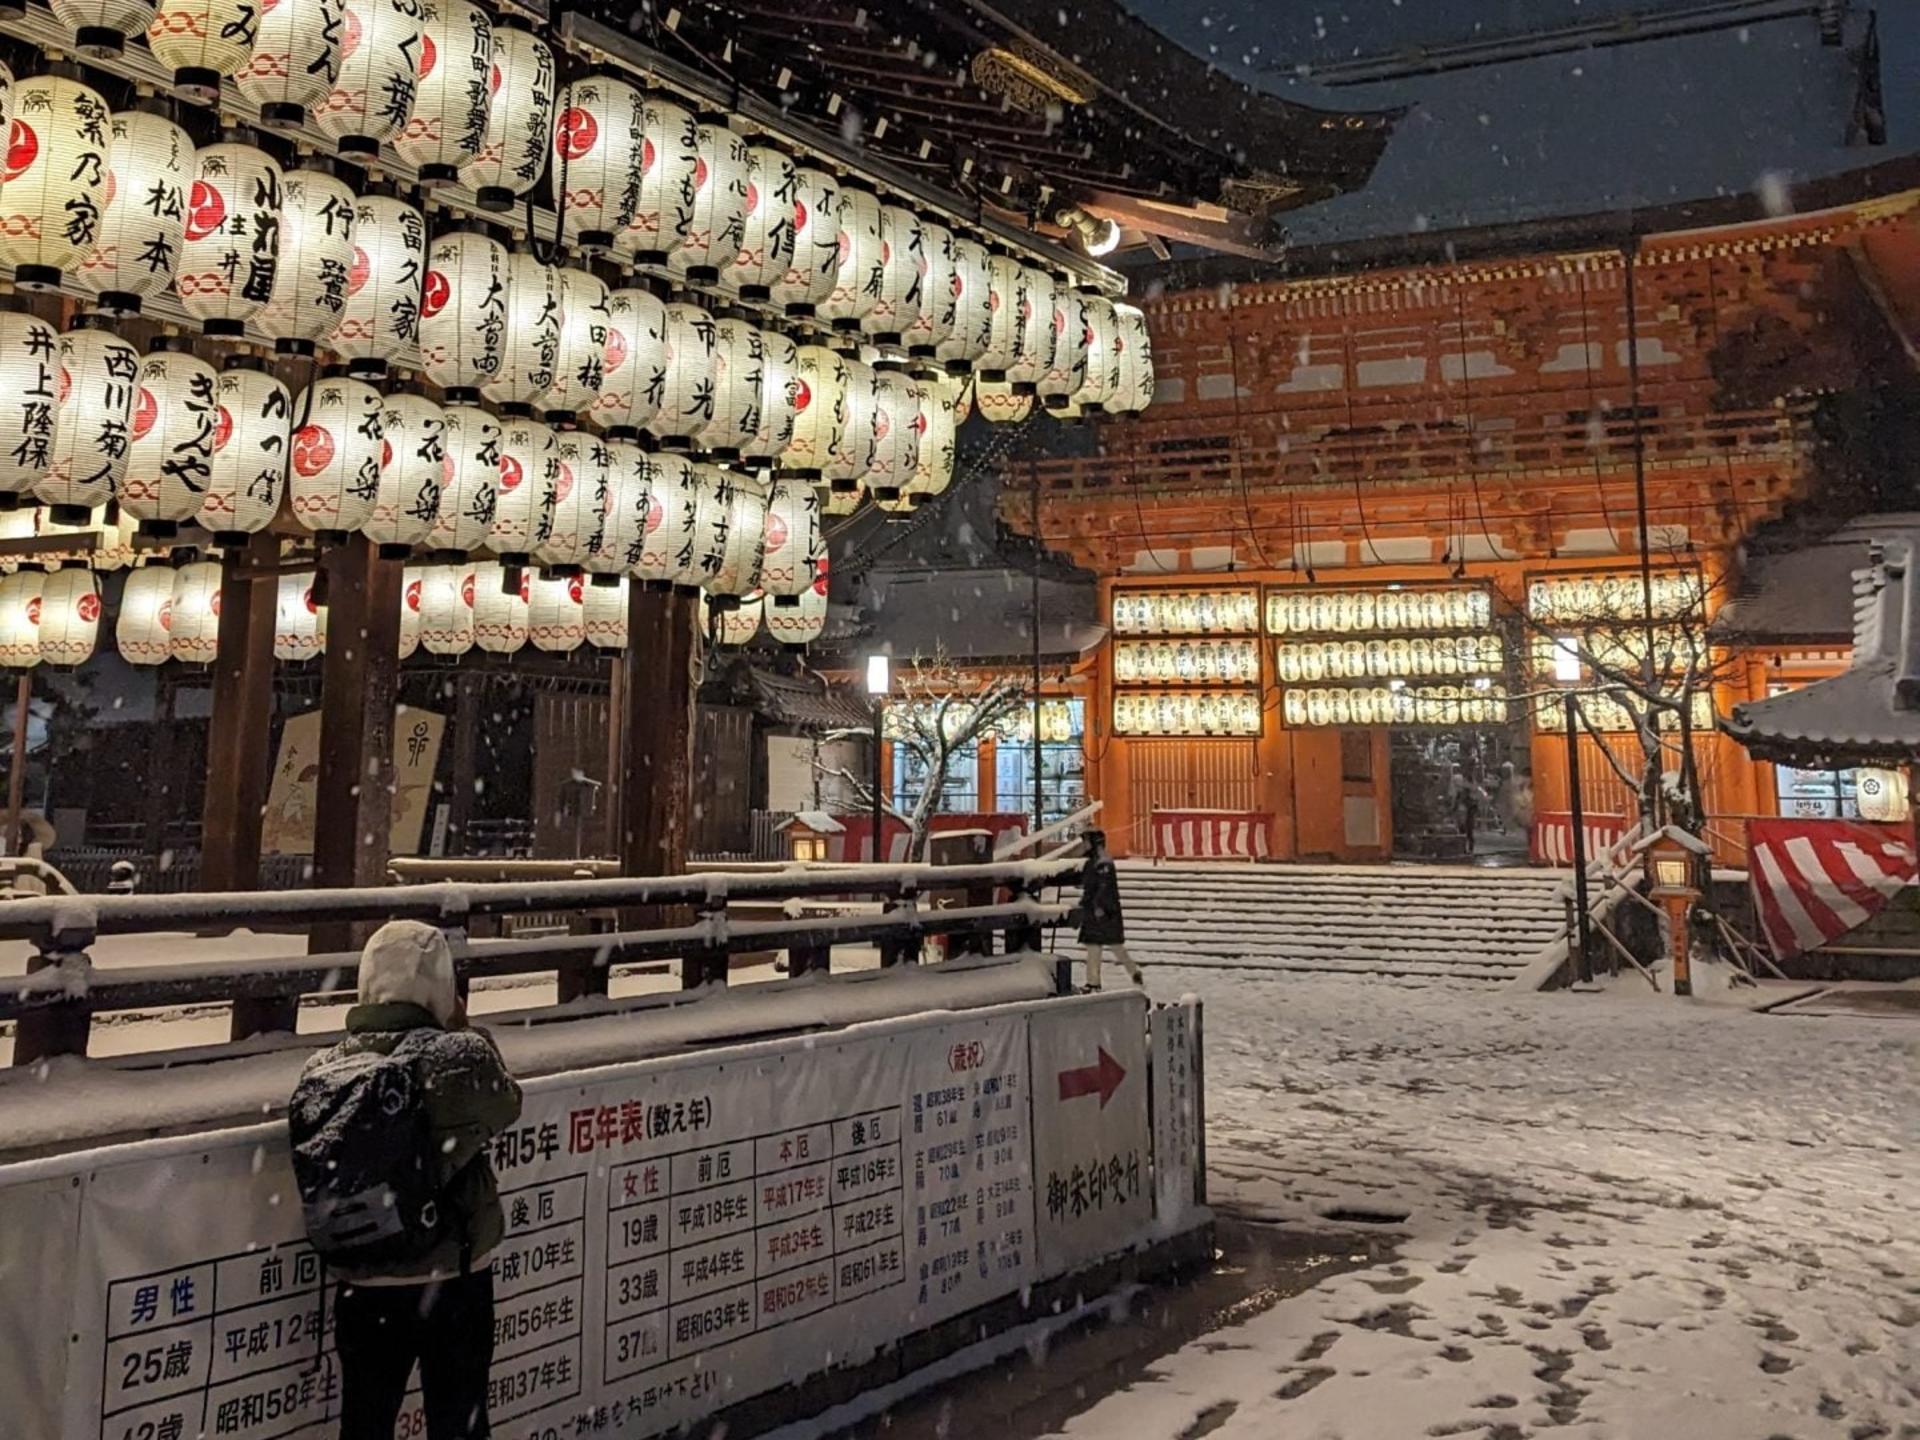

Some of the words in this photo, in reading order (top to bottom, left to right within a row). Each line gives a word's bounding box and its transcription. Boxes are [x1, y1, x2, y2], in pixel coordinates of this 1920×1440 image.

[62, 93, 108, 246] 繁乃家
[136, 178, 186, 272] 松本
[11, 325, 55, 469] 井上隆保
[486, 1122, 560, 1172] 和5年
[779, 1133, 810, 1163] 本厄
[852, 1117, 882, 1146] 後厄
[623, 1165, 660, 1199] 女性
[697, 1151, 732, 1183] 前厄
[837, 1158, 897, 1191] 平成16年生
[510, 1190, 555, 1229] 後厄
[678, 1193, 749, 1234] 平成18年生
[622, 1214, 660, 1249] 19歳
[260, 1251, 317, 1296] 前厄
[618, 1269, 659, 1305] 33歳
[681, 1248, 746, 1287] 平成4年生
[131, 1275, 195, 1325] 男性
[675, 1298, 751, 1344] 昭和63年生
[121, 1340, 193, 1391] 25歳
[216, 1369, 339, 1436] 昭和58年生
